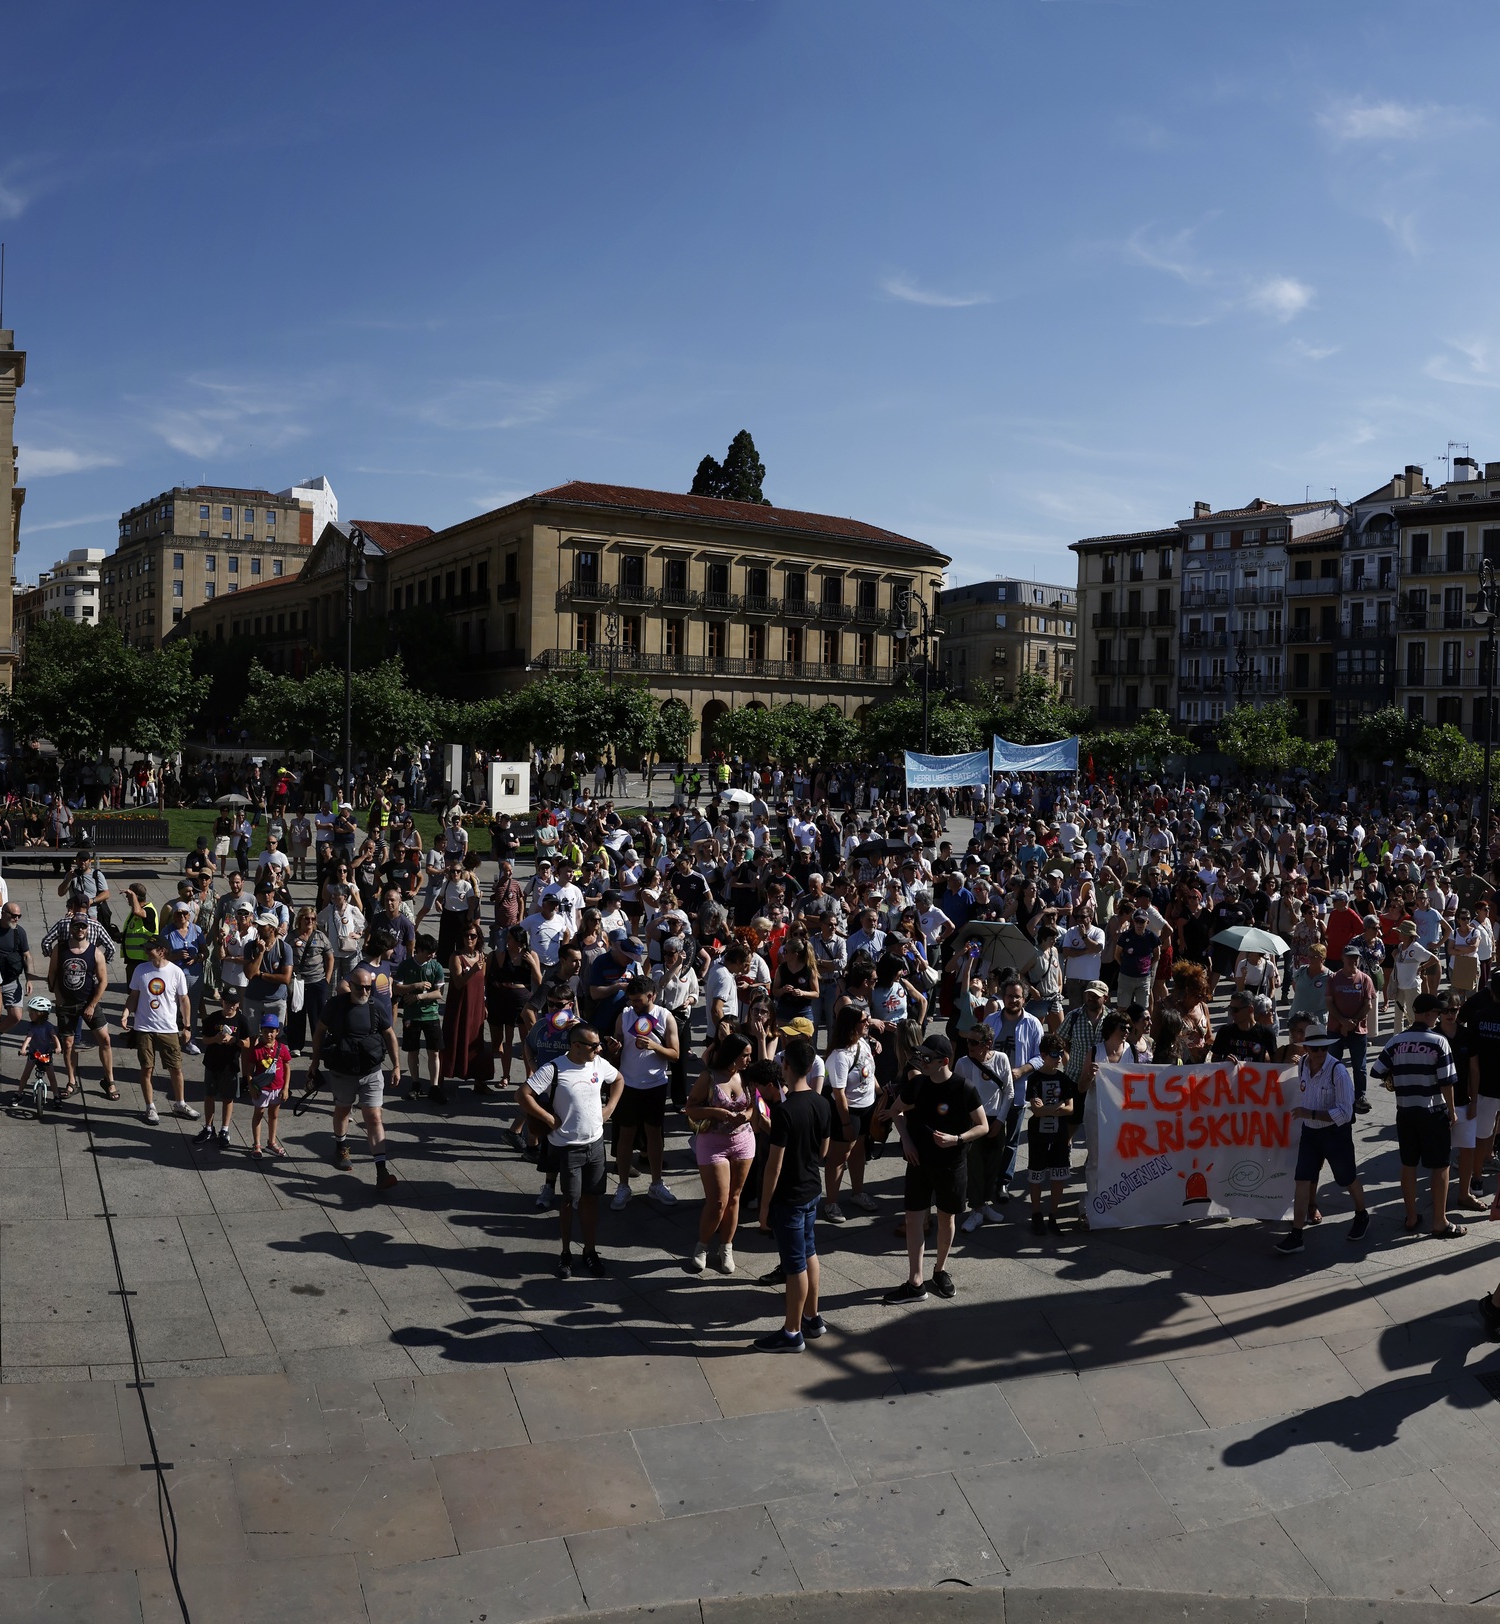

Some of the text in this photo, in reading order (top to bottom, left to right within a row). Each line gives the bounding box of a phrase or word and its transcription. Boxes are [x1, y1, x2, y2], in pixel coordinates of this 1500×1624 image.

[1207, 549, 1264, 561] EL CISNE
[914, 771, 981, 782] HERRI LIBRE BATEAN
[1122, 1066, 1285, 1111] EUSKARA
